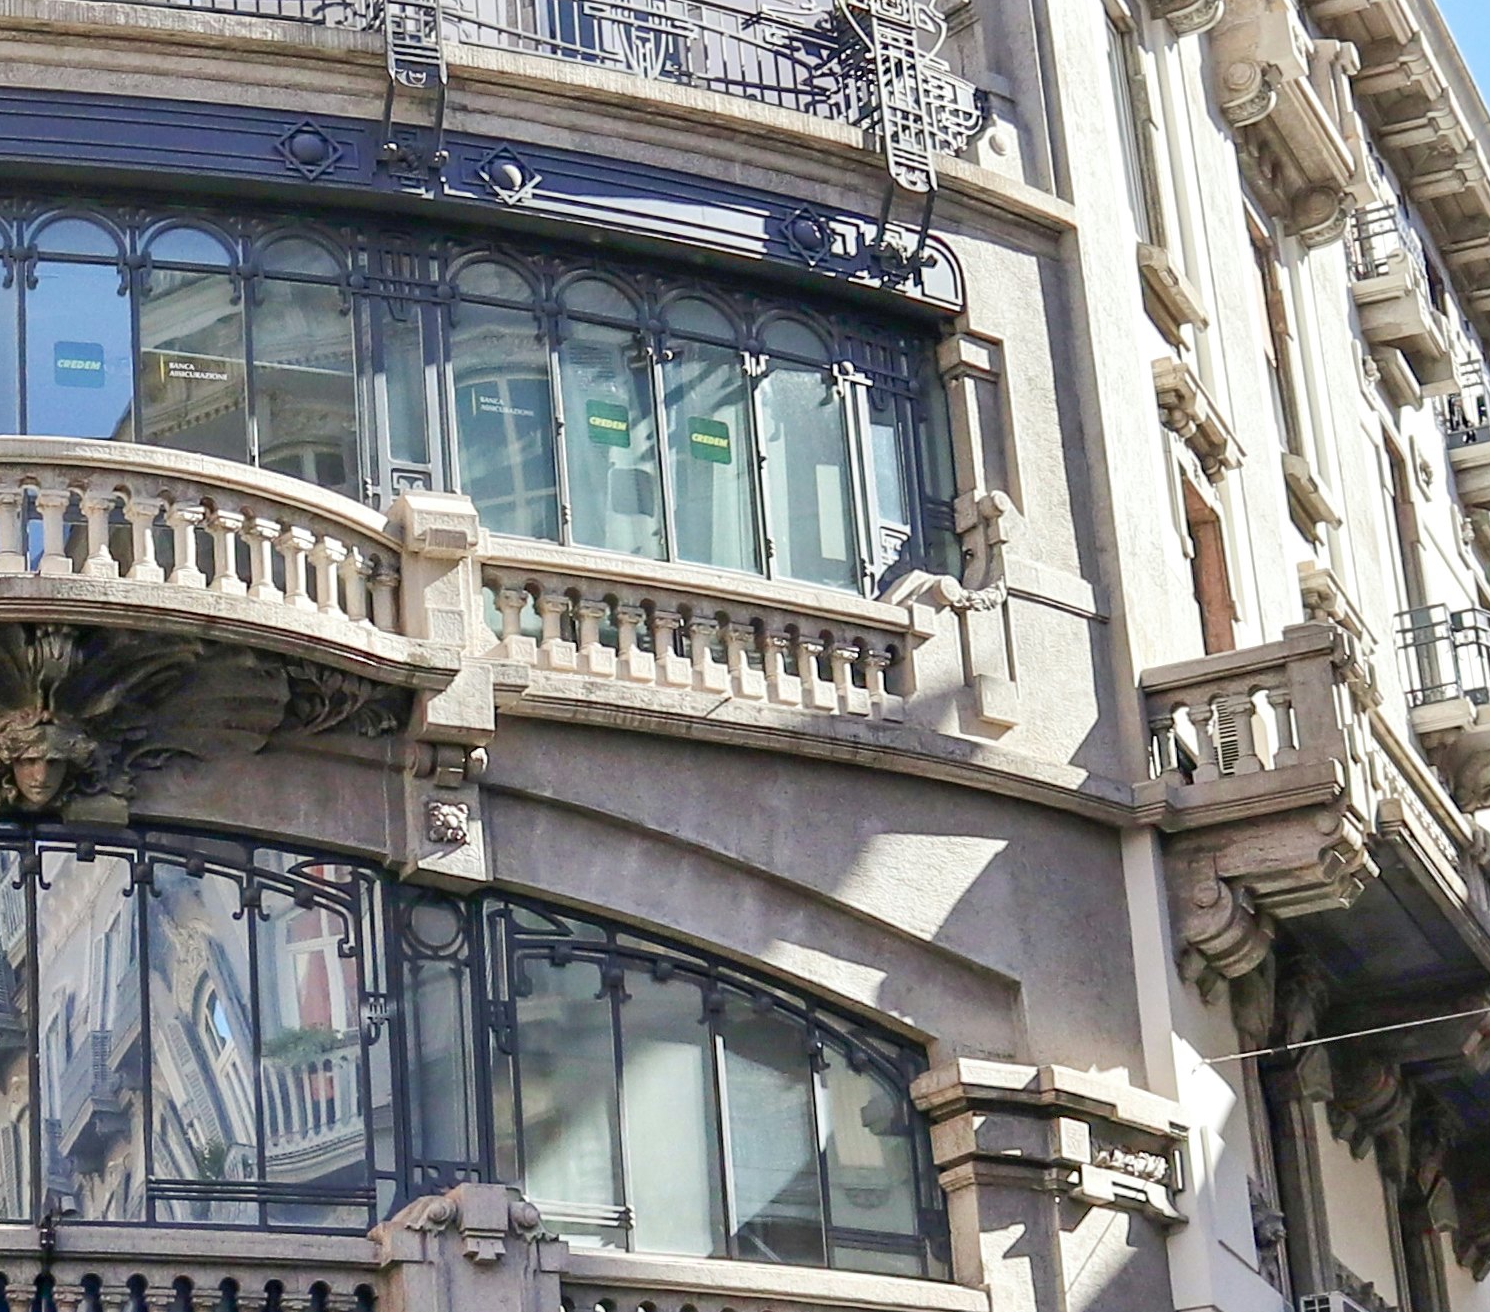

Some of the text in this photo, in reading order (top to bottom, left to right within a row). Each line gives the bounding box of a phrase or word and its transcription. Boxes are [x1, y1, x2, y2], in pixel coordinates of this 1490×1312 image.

[56, 358, 102, 371] CREDEM
[168, 361, 196, 371] BANCA
[168, 370, 229, 382] ASSICURAZIONE
[479, 395, 505, 406] BANCA
[588, 416, 629, 432] CREDEM
[691, 433, 728, 448] CREDEM
